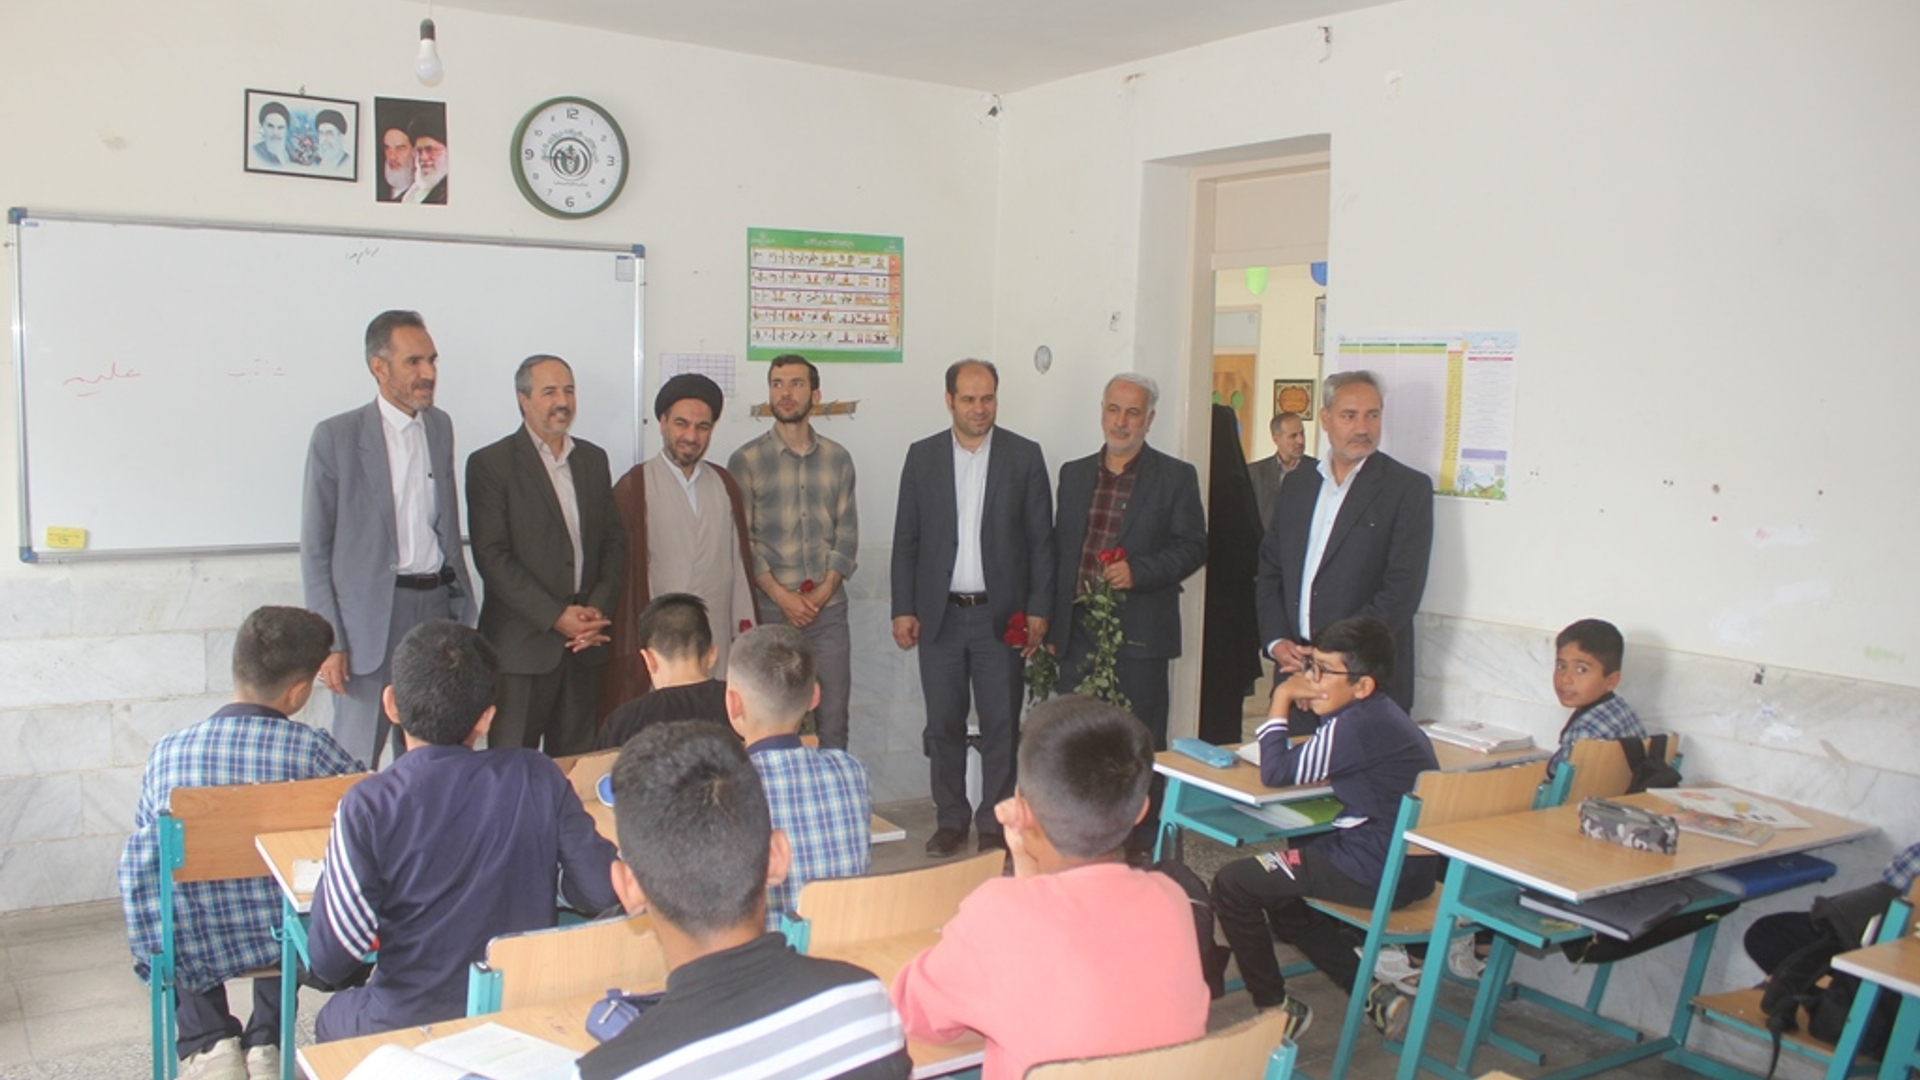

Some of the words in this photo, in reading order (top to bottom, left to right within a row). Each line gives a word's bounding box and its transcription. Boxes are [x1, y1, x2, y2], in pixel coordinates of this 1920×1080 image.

[566, 109, 579, 120] 12
[525, 149, 534, 160] 9
[607, 156, 615, 167] 3
[565, 196, 575, 207] 6
